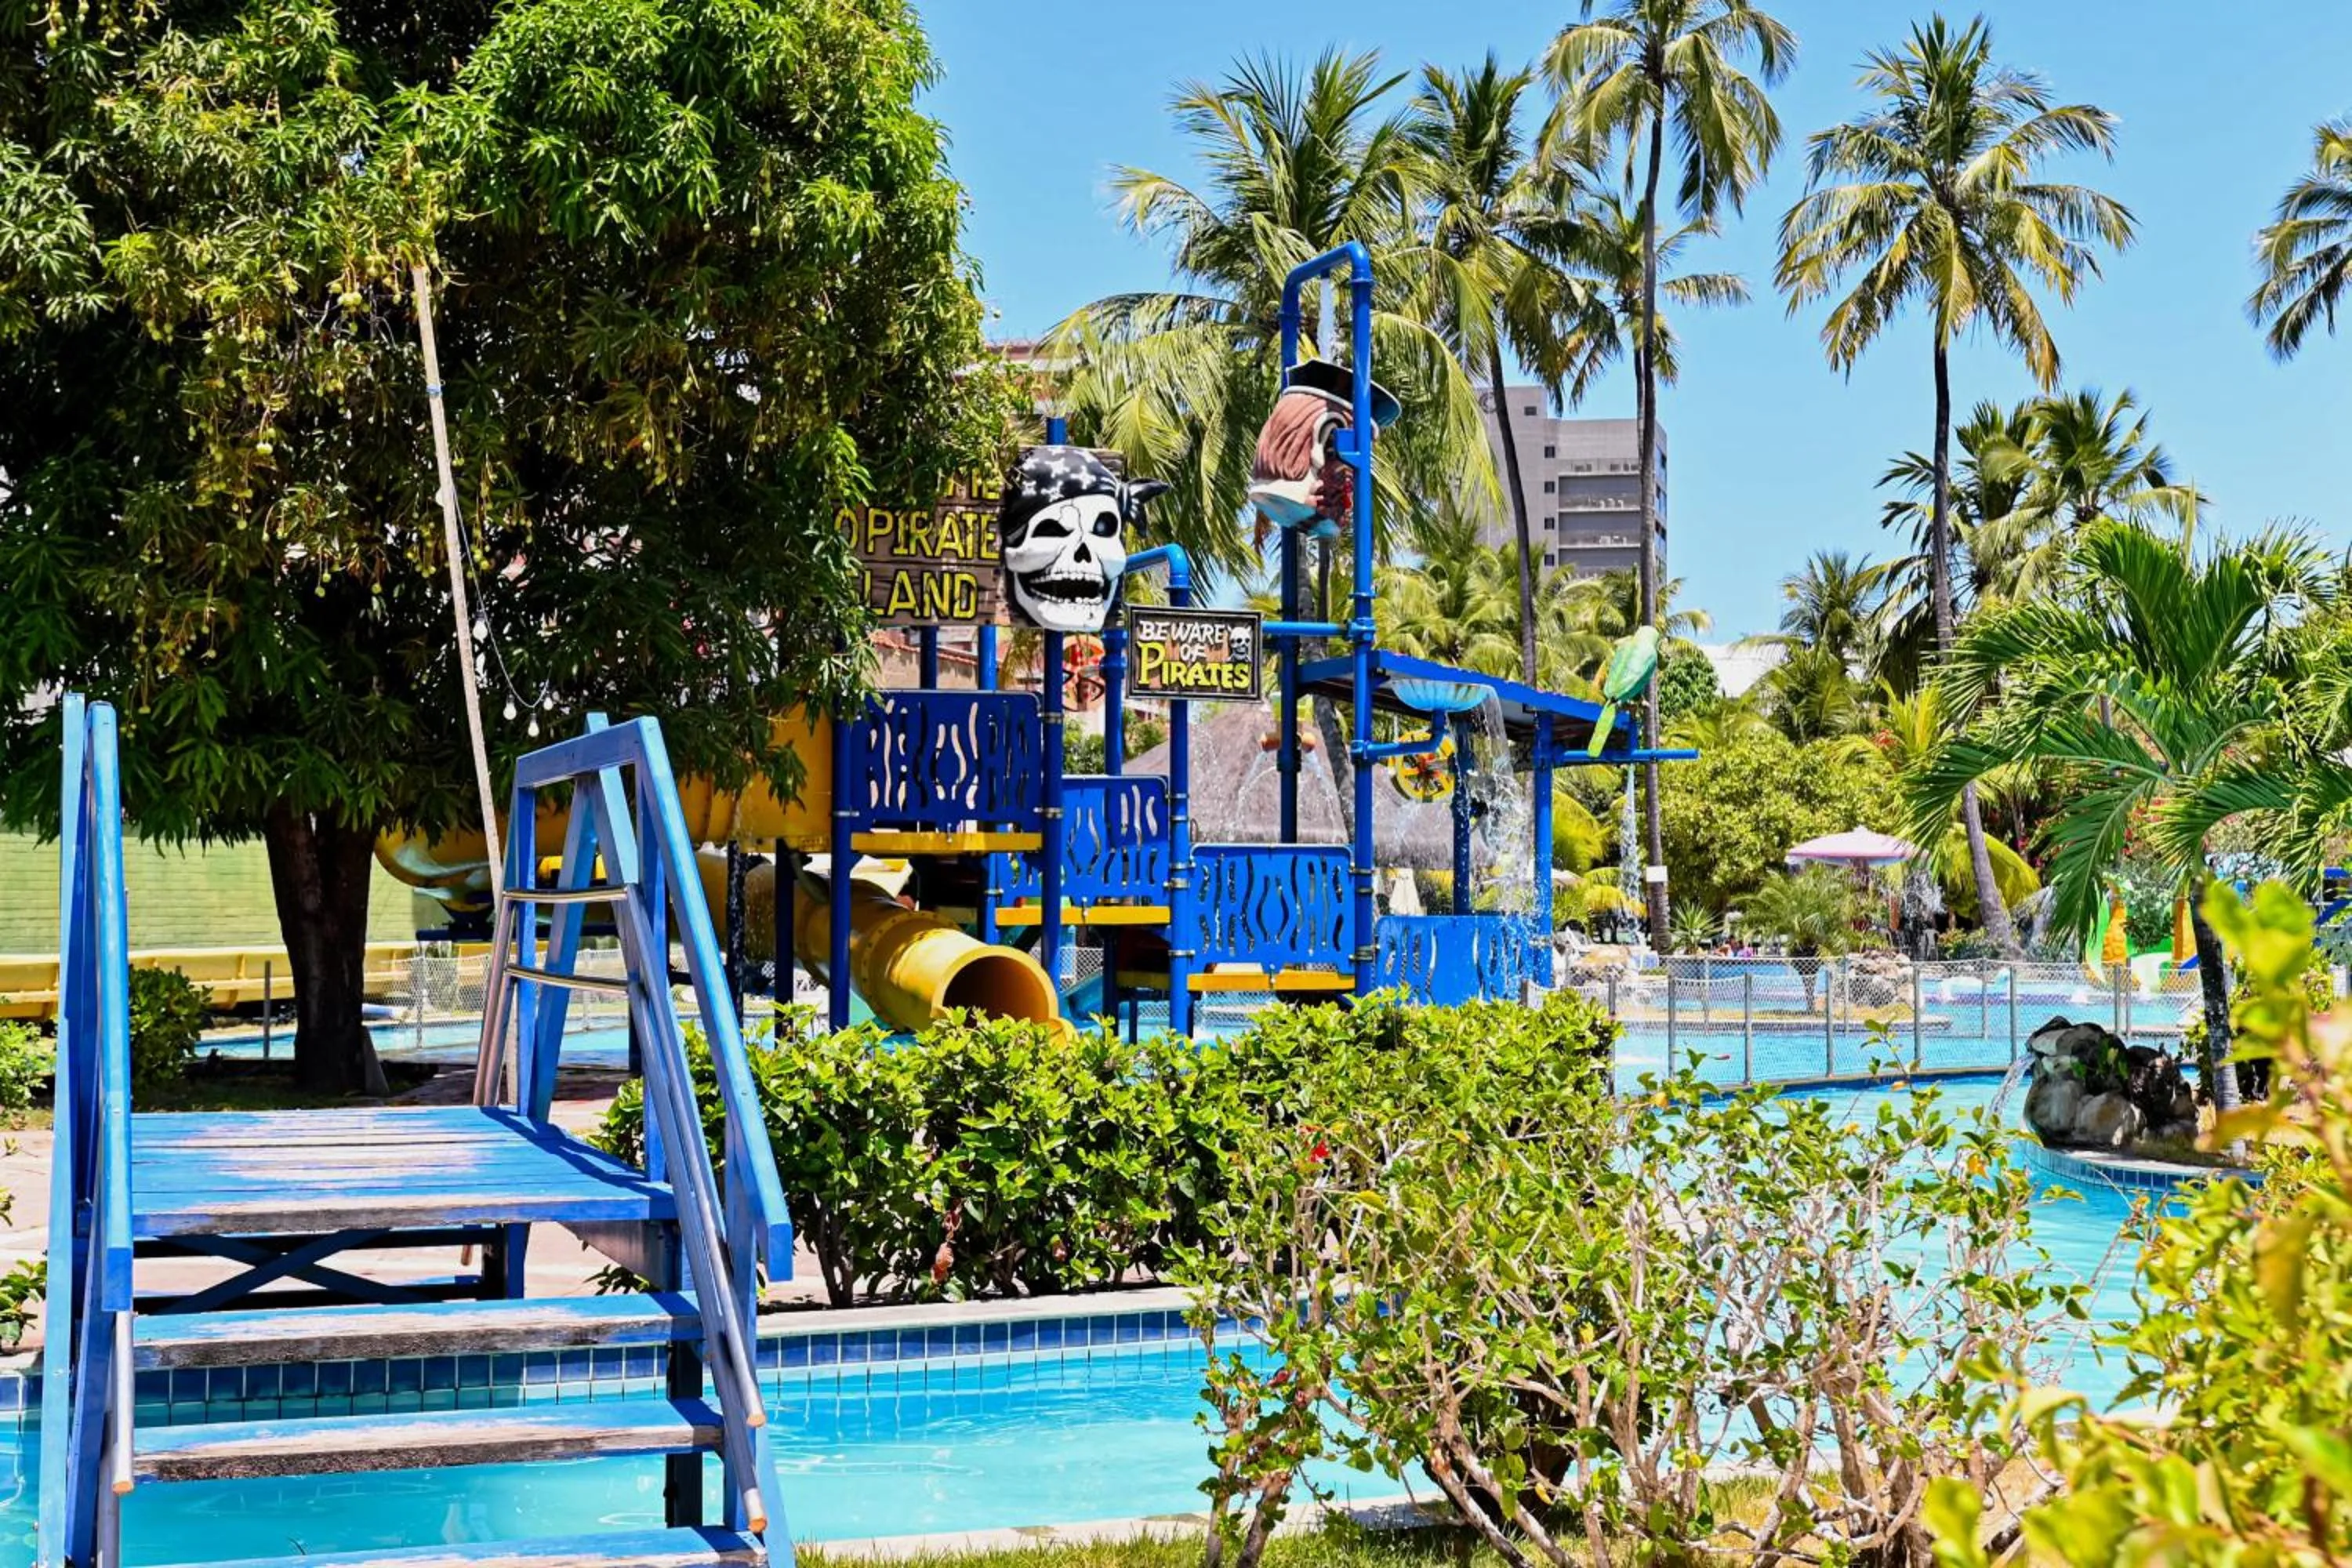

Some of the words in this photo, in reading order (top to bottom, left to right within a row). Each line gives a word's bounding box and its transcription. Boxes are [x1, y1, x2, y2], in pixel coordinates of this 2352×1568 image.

[867, 508, 1000, 560] PIRATE
[848, 570, 978, 619] LAND
[1139, 620, 1225, 644] BEWARE
[1180, 643, 1206, 662] OF
[1137, 641, 1250, 688] PIRATES
